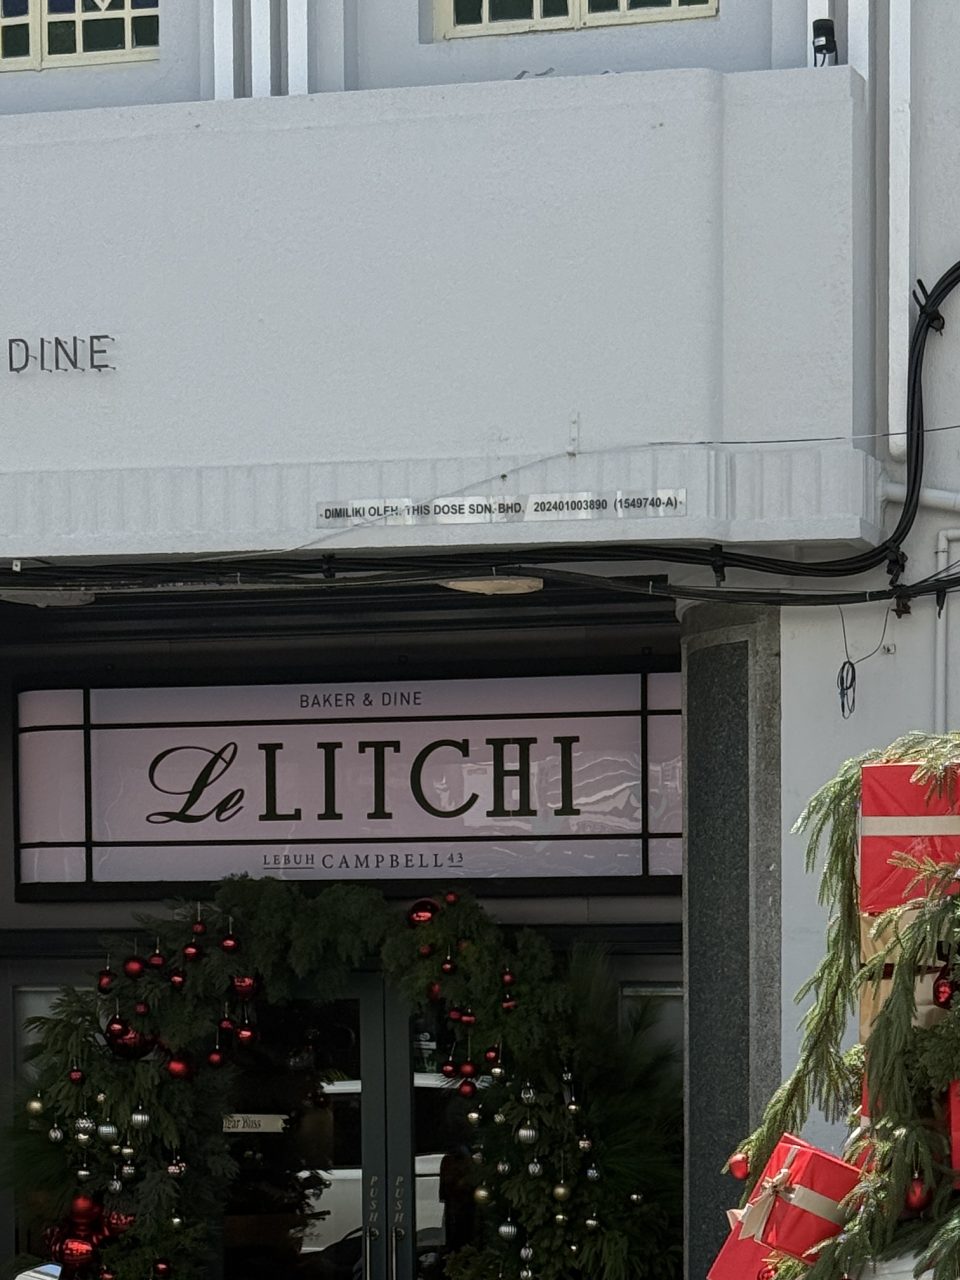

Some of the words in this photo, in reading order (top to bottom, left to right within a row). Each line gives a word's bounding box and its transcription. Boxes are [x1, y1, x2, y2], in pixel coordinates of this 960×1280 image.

[8, 334, 110, 372] DINE
[324, 506, 365, 519] DIMILIKI
[405, 504, 430, 516] THIS
[433, 503, 465, 515] DOSE
[469, 503, 495, 514] SDN.
[498, 502, 525, 514] BHD.
[534, 499, 607, 513] 202401003890
[614, 497, 677, 510] (1549740-A)
[300, 693, 356, 708] BAKER
[363, 692, 373, 707] &
[382, 691, 422, 706] DINE
[145, 741, 245, 824] Le
[258, 735, 580, 821] LITCHI
[263, 853, 315, 866] LEBUH
[322, 853, 443, 869] CAMPBELL
[448, 852, 464, 863] 43
[370, 1175, 378, 1222] PUSH
[395, 1175, 404, 1223] PUSH
